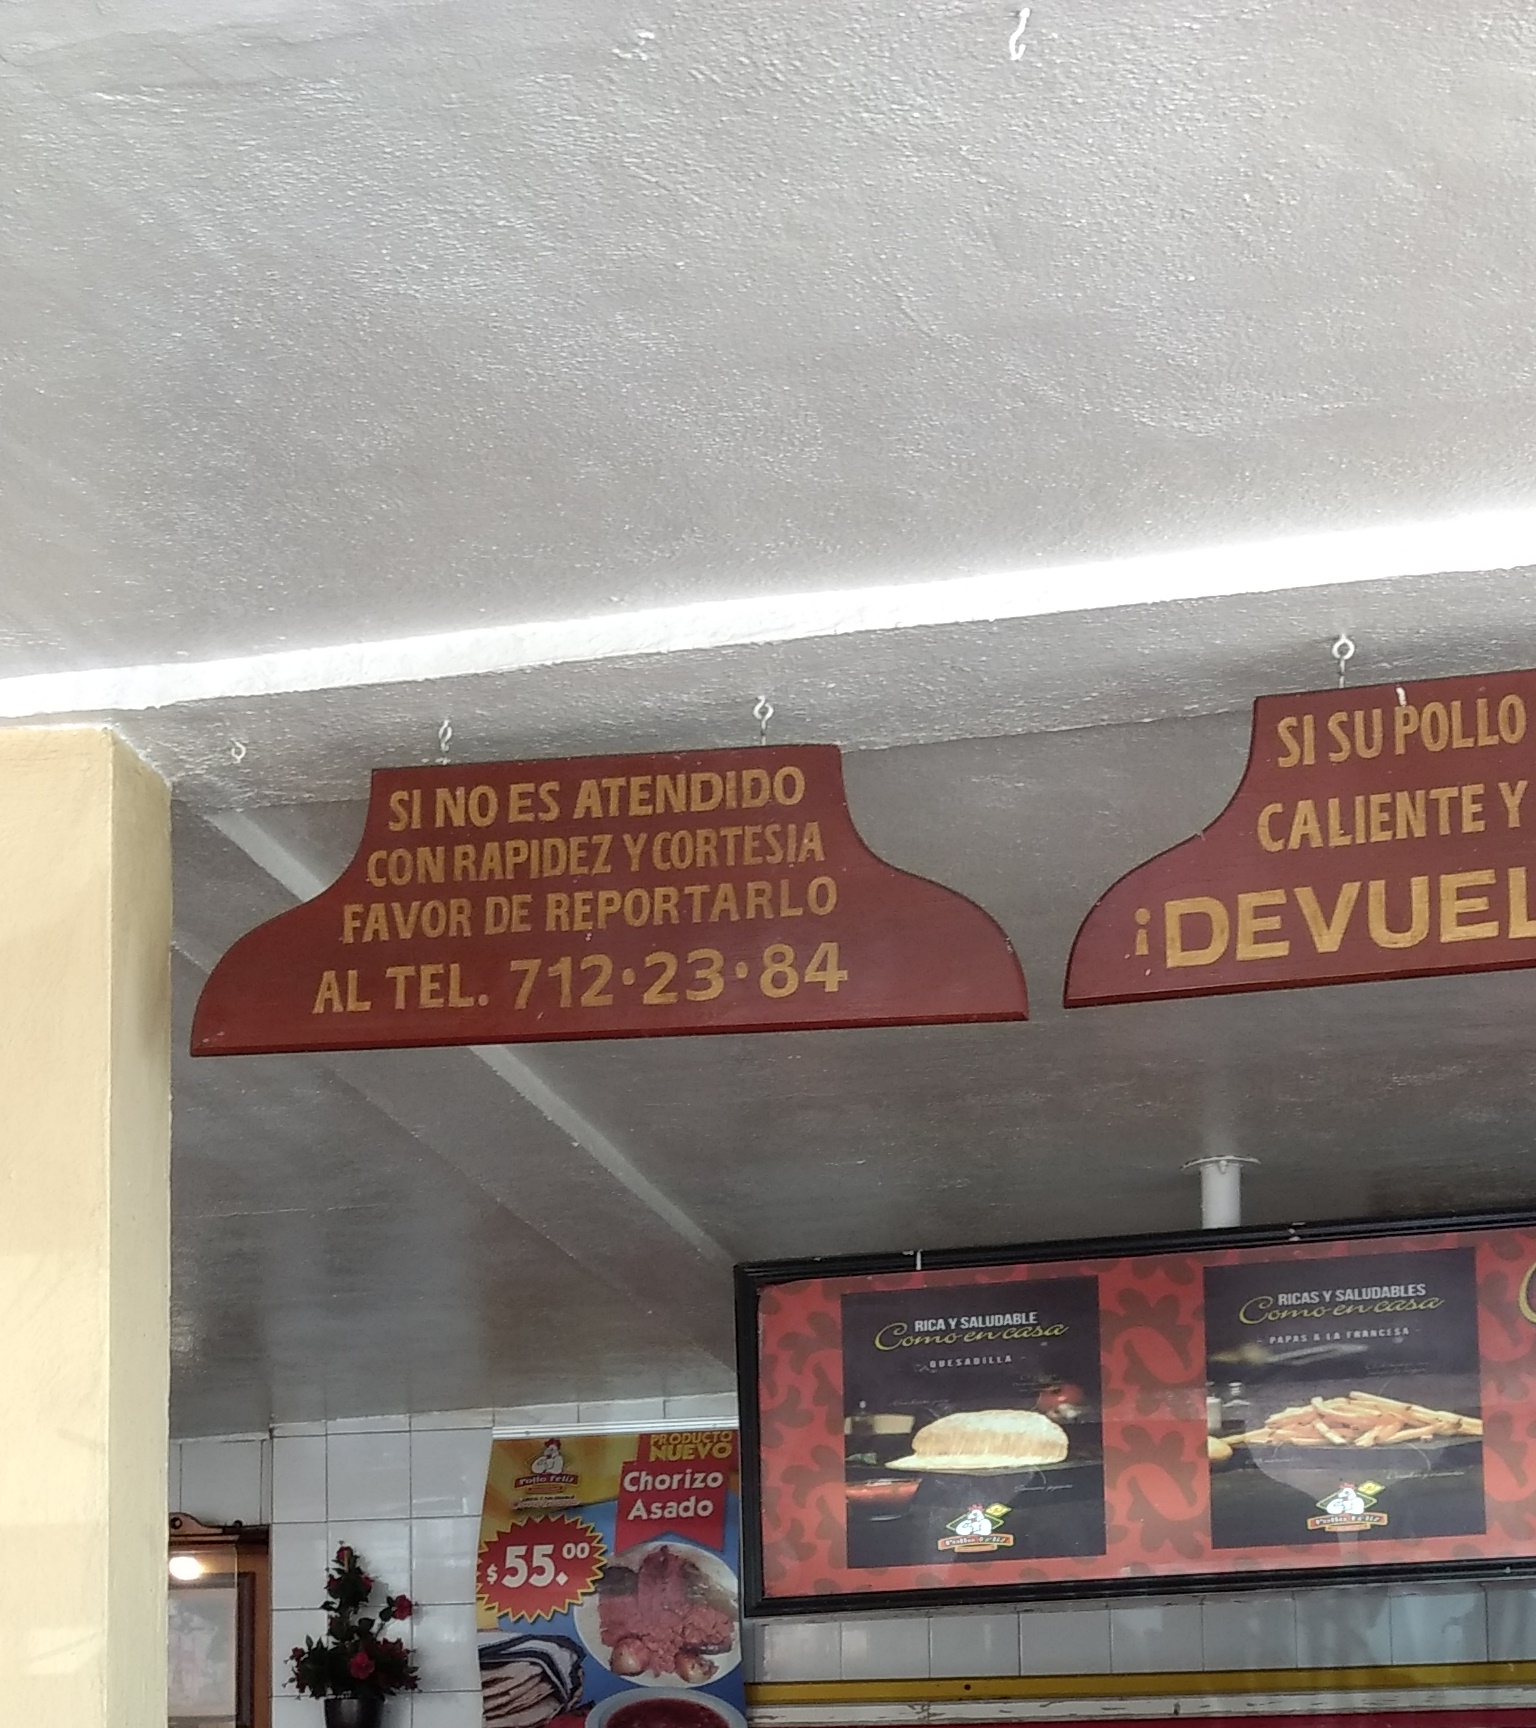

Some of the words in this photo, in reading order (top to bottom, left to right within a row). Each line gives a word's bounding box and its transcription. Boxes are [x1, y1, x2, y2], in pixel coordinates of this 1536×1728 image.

[1277, 713, 1315, 768] SI
[1328, 707, 1384, 764] SU
[1393, 696, 1527, 758] POLLO
[388, 788, 421, 833] SI
[436, 783, 499, 828] NO
[509, 779, 562, 824] ES
[574, 766, 807, 818] ATENDIDO
[1256, 782, 1486, 853] CALIENTE
[1497, 779, 1528, 828] Y
[367, 846, 445, 888] CON
[453, 833, 613, 882] RAPIDEZ
[623, 831, 645, 874] Y
[651, 821, 827, 870] CORTESIA
[342, 897, 473, 944] FAVOR
[485, 893, 532, 936] DE
[545, 875, 839, 932] REPORTARLO
[312, 968, 371, 1015] AL
[386, 960, 490, 1010] TEL.
[1278, 1291, 1320, 1306] RICAS
[1322, 1290, 1333, 1302] Y
[1335, 1283, 1427, 1301] SALUDABLES
[915, 1318, 946, 1332] RICA
[948, 1318, 959, 1329] Y
[960, 1311, 1038, 1328] SALUDABLE
[1239, 1296, 1329, 1324] Como
[1332, 1303, 1373, 1316] en
[1373, 1297, 1444, 1312] casa
[874, 1322, 962, 1351] Como
[964, 1326, 1002, 1342] en
[1002, 1324, 1069, 1339] casa
[1270, 1335, 1308, 1344] PAPAS
[1347, 1327, 1410, 1338] FRANCESA
[929, 1355, 1012, 1368] QUESADILLA
[649, 1442, 733, 1461] NUEVO
[650, 1432, 733, 1446] PRODUCTO
[623, 1469, 724, 1492] Chorizo
[627, 1495, 714, 1520] Asado
